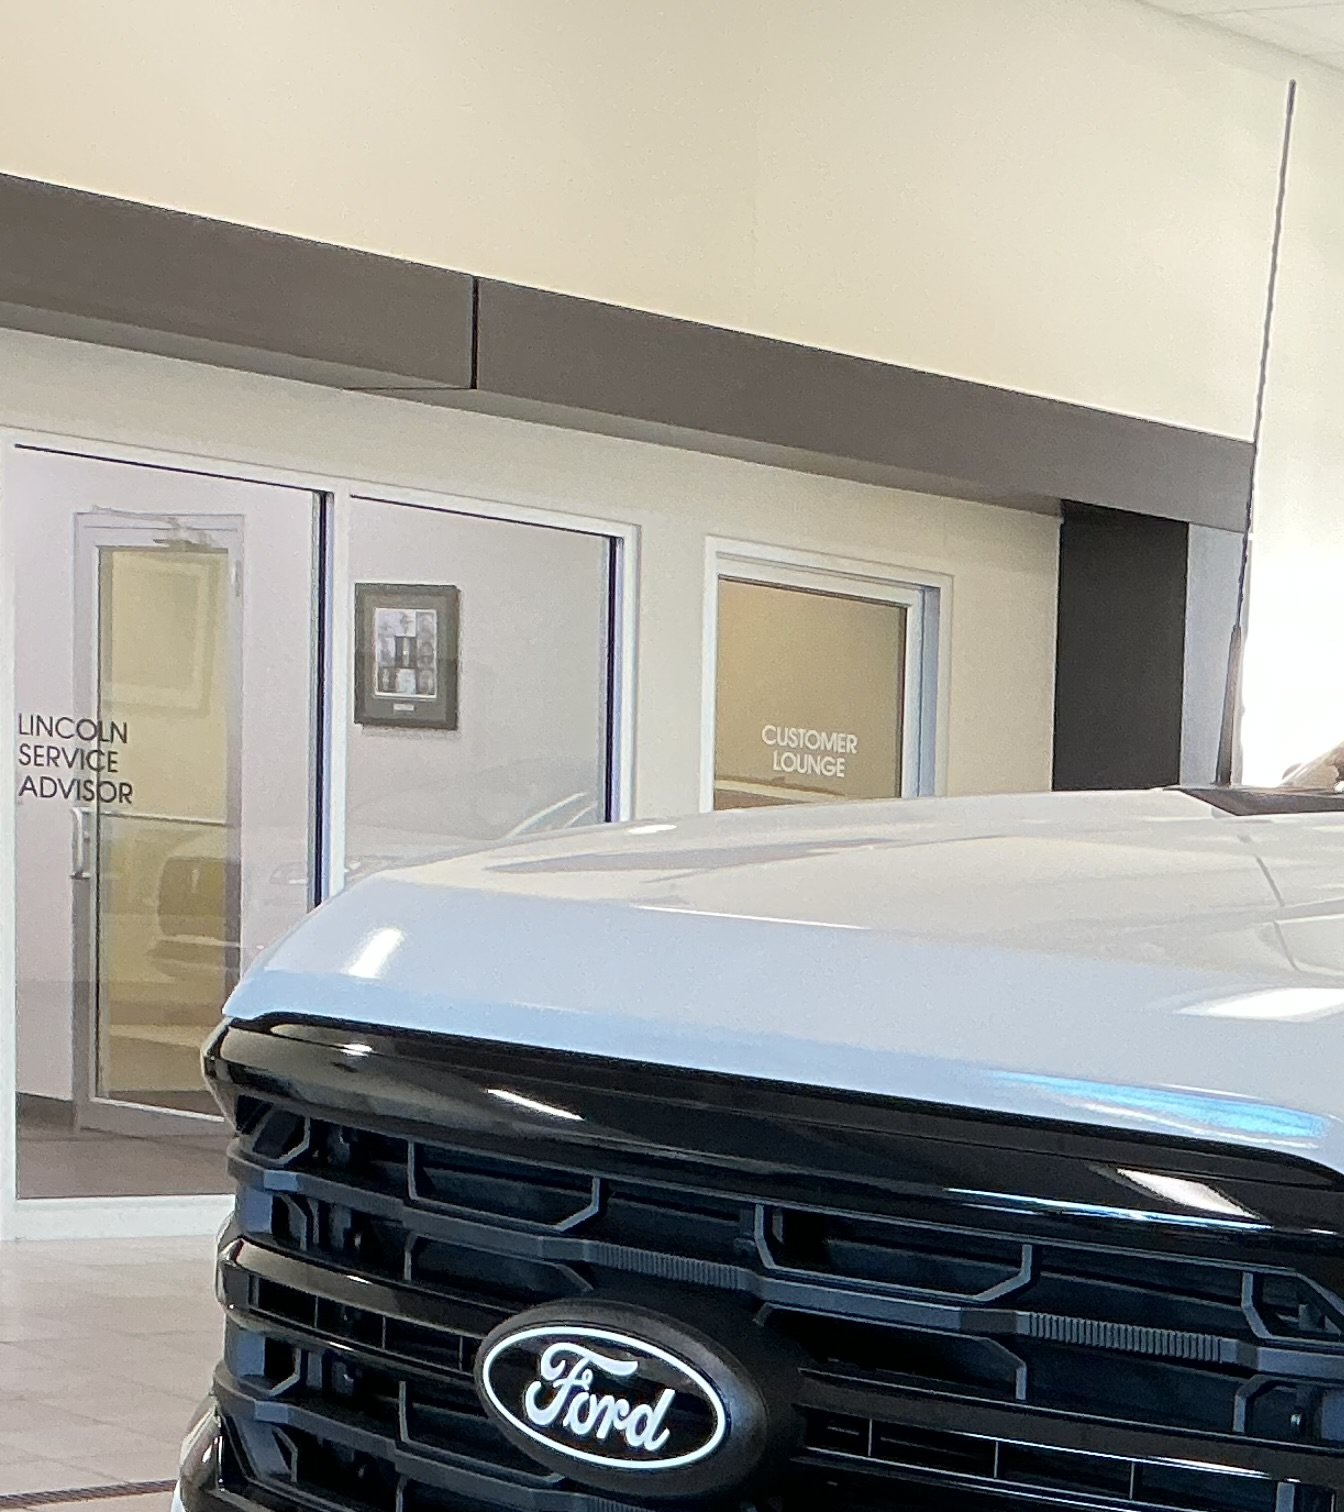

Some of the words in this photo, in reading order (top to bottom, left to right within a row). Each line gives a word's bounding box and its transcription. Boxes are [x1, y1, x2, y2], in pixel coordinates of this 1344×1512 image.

[18, 712, 128, 744] LINCOLN
[761, 724, 858, 754] CUSTOMER
[18, 742, 119, 773] SERVICE
[773, 749, 845, 778] LOUNGE
[18, 774, 134, 805] ADVISOR
[524, 1341, 677, 1452] Ford
